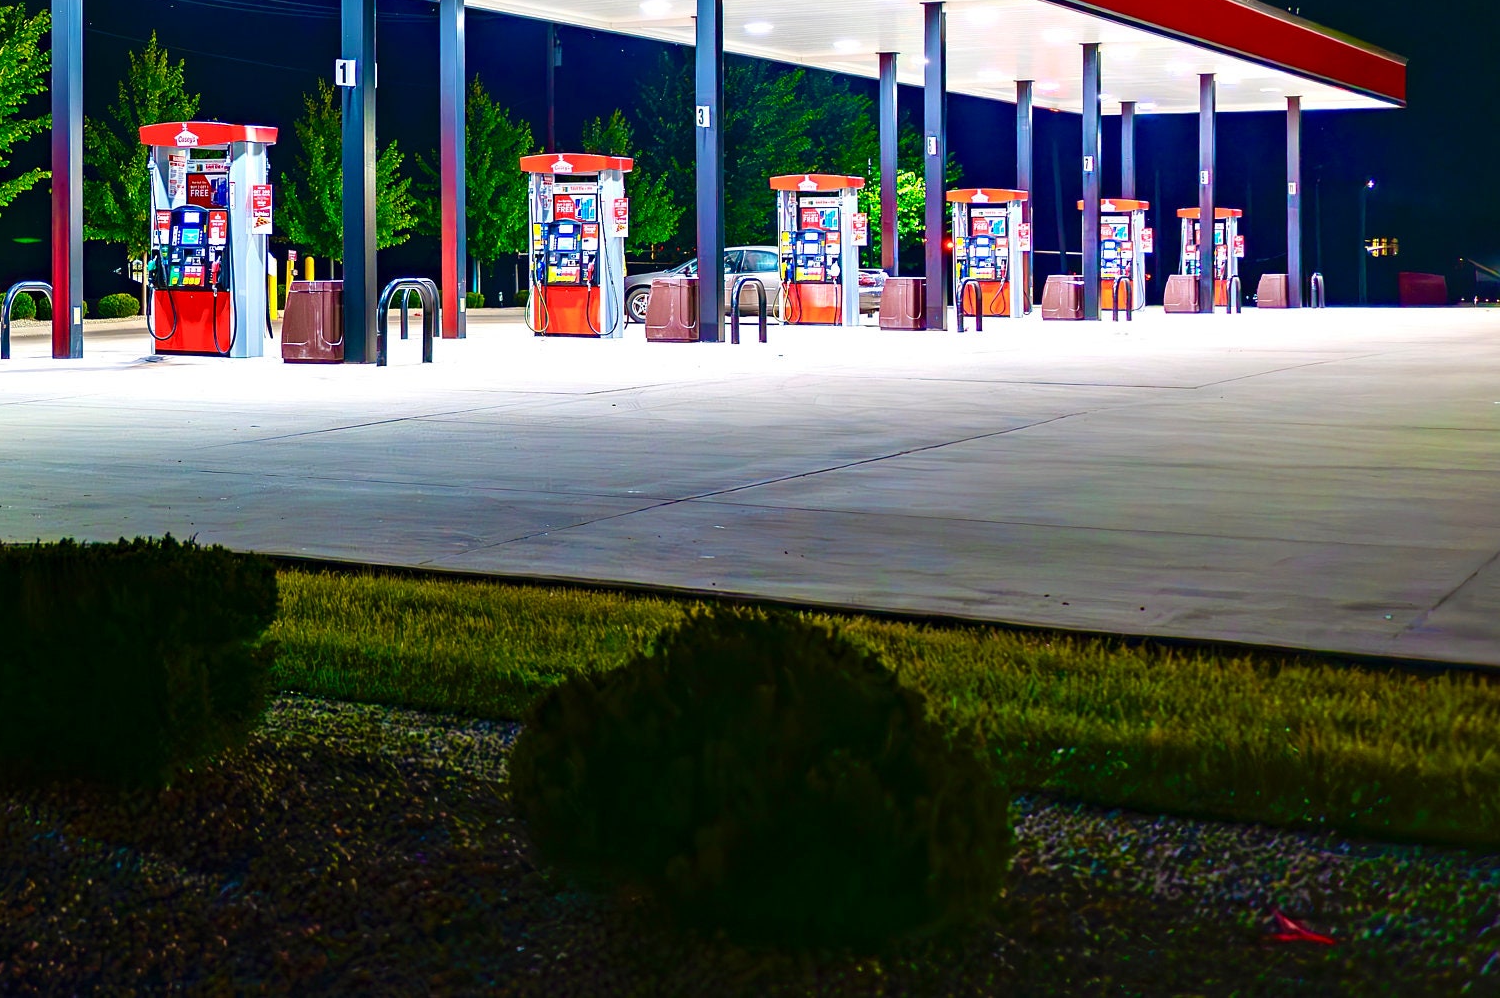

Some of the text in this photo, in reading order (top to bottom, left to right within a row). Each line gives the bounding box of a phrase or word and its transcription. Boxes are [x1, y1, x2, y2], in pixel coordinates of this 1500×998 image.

[340, 62, 347, 83] 1
[698, 108, 704, 125] 3
[190, 189, 209, 197] FREE
